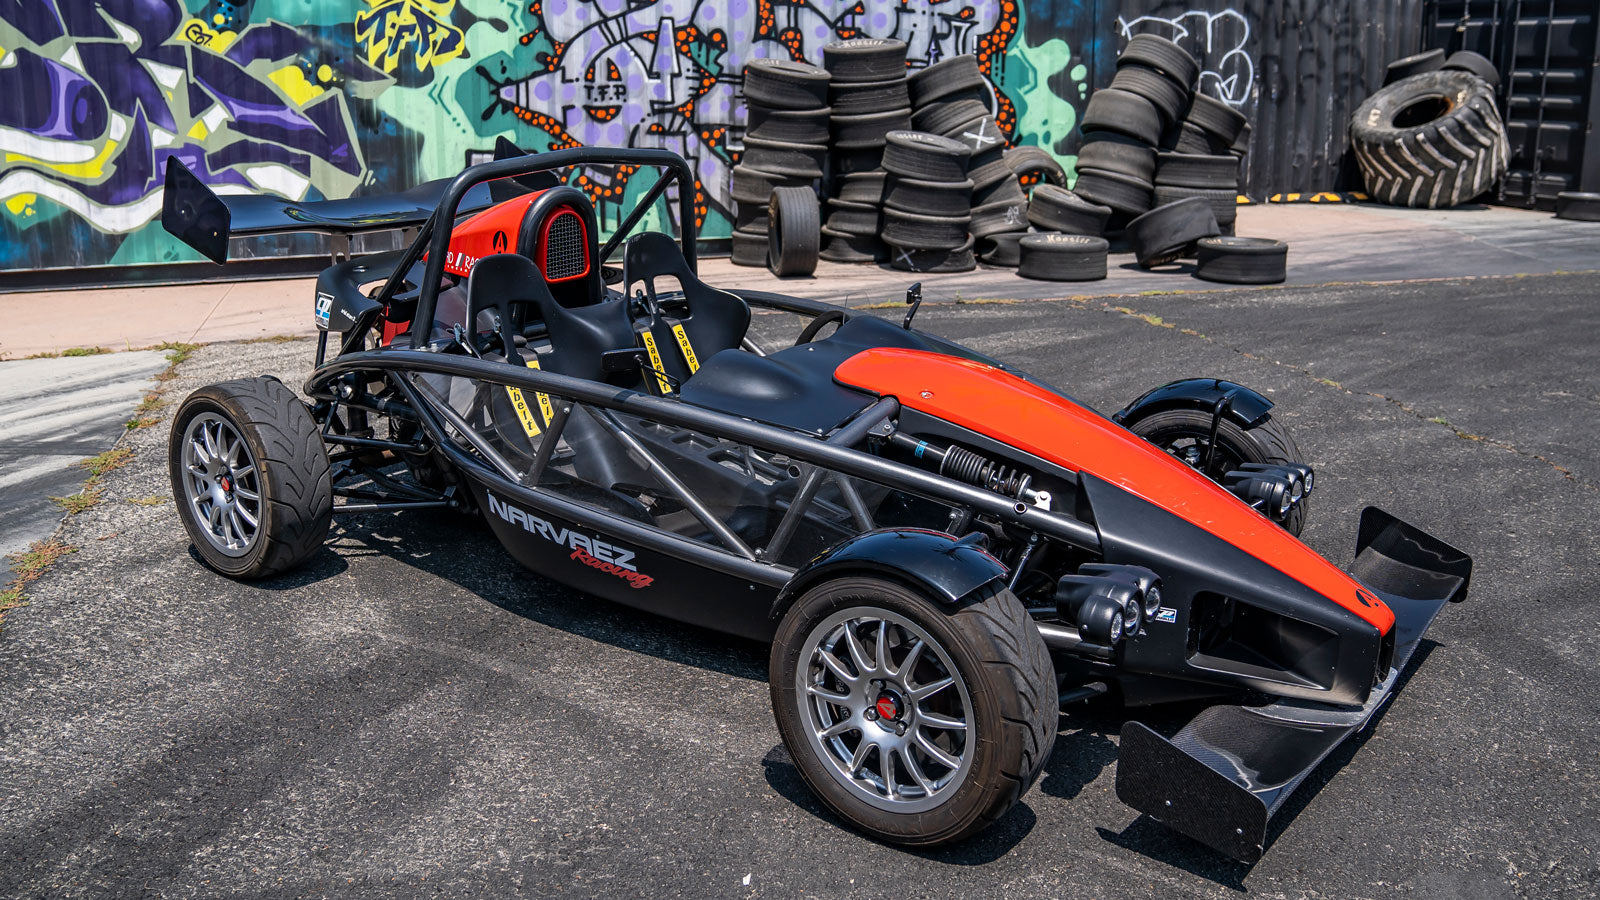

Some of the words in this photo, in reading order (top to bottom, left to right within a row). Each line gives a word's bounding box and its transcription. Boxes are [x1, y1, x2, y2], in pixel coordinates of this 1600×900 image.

[583, 84, 627, 102] T.F.P.
[677, 330, 697, 371] Sabel
[510, 387, 533, 431] belt
[570, 545, 654, 589] Racing
